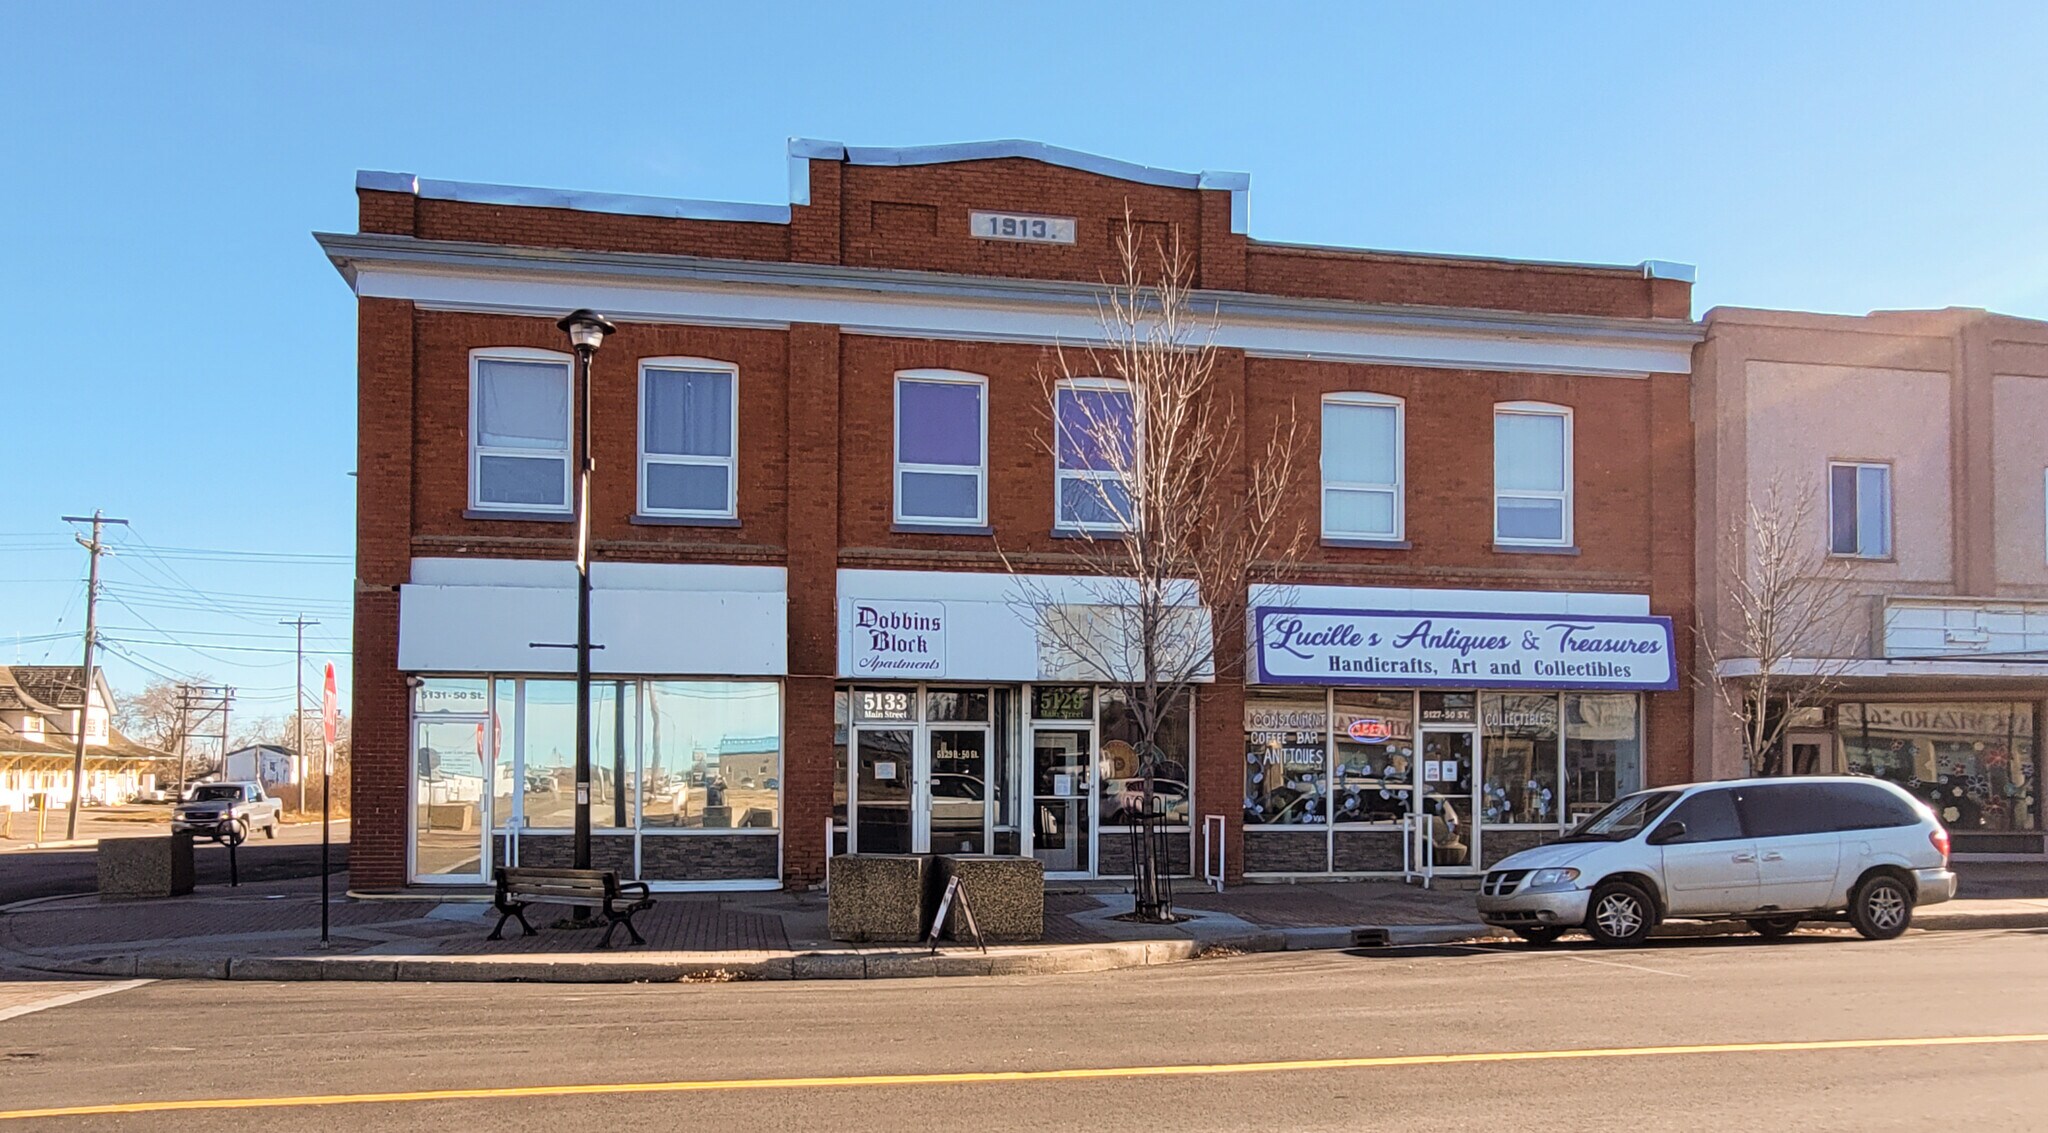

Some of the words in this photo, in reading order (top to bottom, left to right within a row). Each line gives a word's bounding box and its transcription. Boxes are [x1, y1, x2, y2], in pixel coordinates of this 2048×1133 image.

[990, 217, 1057, 239] 1913.
[856, 606, 941, 631] Dobbins
[869, 629, 928, 653] Block
[1393, 620, 1511, 657] Antiques
[1521, 630, 1541, 650] &
[1545, 623, 1662, 654] Treasures
[859, 654, 940, 672] Apartments
[1329, 655, 1438, 675] Handicrafts,
[1451, 658, 1477, 674] Art
[1490, 659, 1521, 675] and
[1534, 659, 1631, 677] Collectibles
[864, 692, 907, 710] 5133
[1040, 692, 1084, 710] 5129
[864, 710, 884, 719] Main
[885, 710, 907, 719] Street
[1253, 713, 1326, 728] CONSIGNMENT
[1485, 712, 1553, 726] COLLECTIBLES
[1250, 731, 1287, 745] COFFEE
[1296, 731, 1319, 744] BAR
[1263, 747, 1324, 765] ANTIQUES
